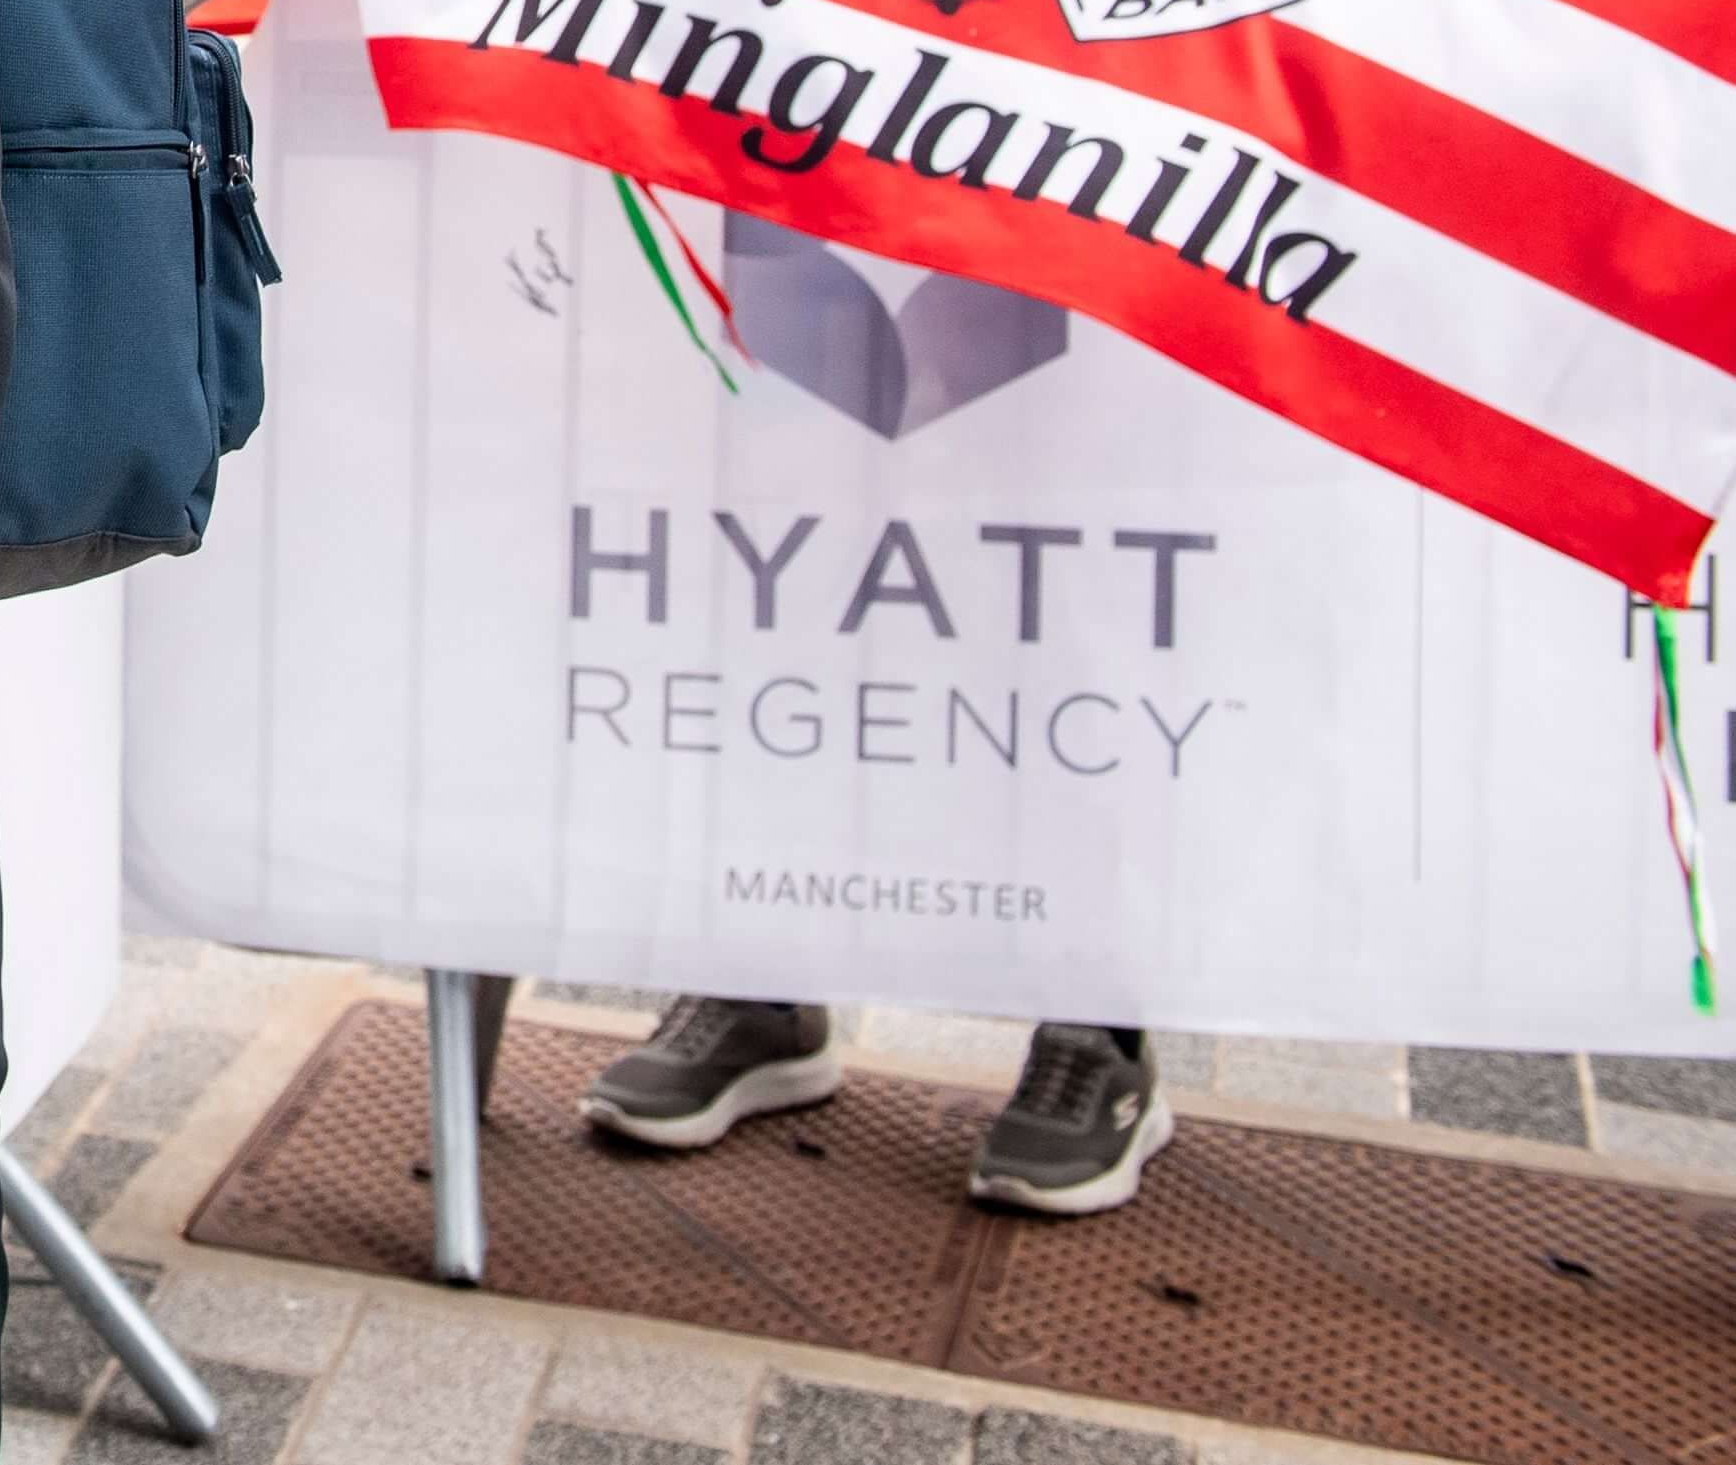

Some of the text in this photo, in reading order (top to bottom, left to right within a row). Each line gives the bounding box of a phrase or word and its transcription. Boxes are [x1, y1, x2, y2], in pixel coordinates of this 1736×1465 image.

[566, 504, 1218, 650] HYATT
[564, 666, 1214, 779] REGENCY
[723, 865, 1049, 924] MANCHESTER
